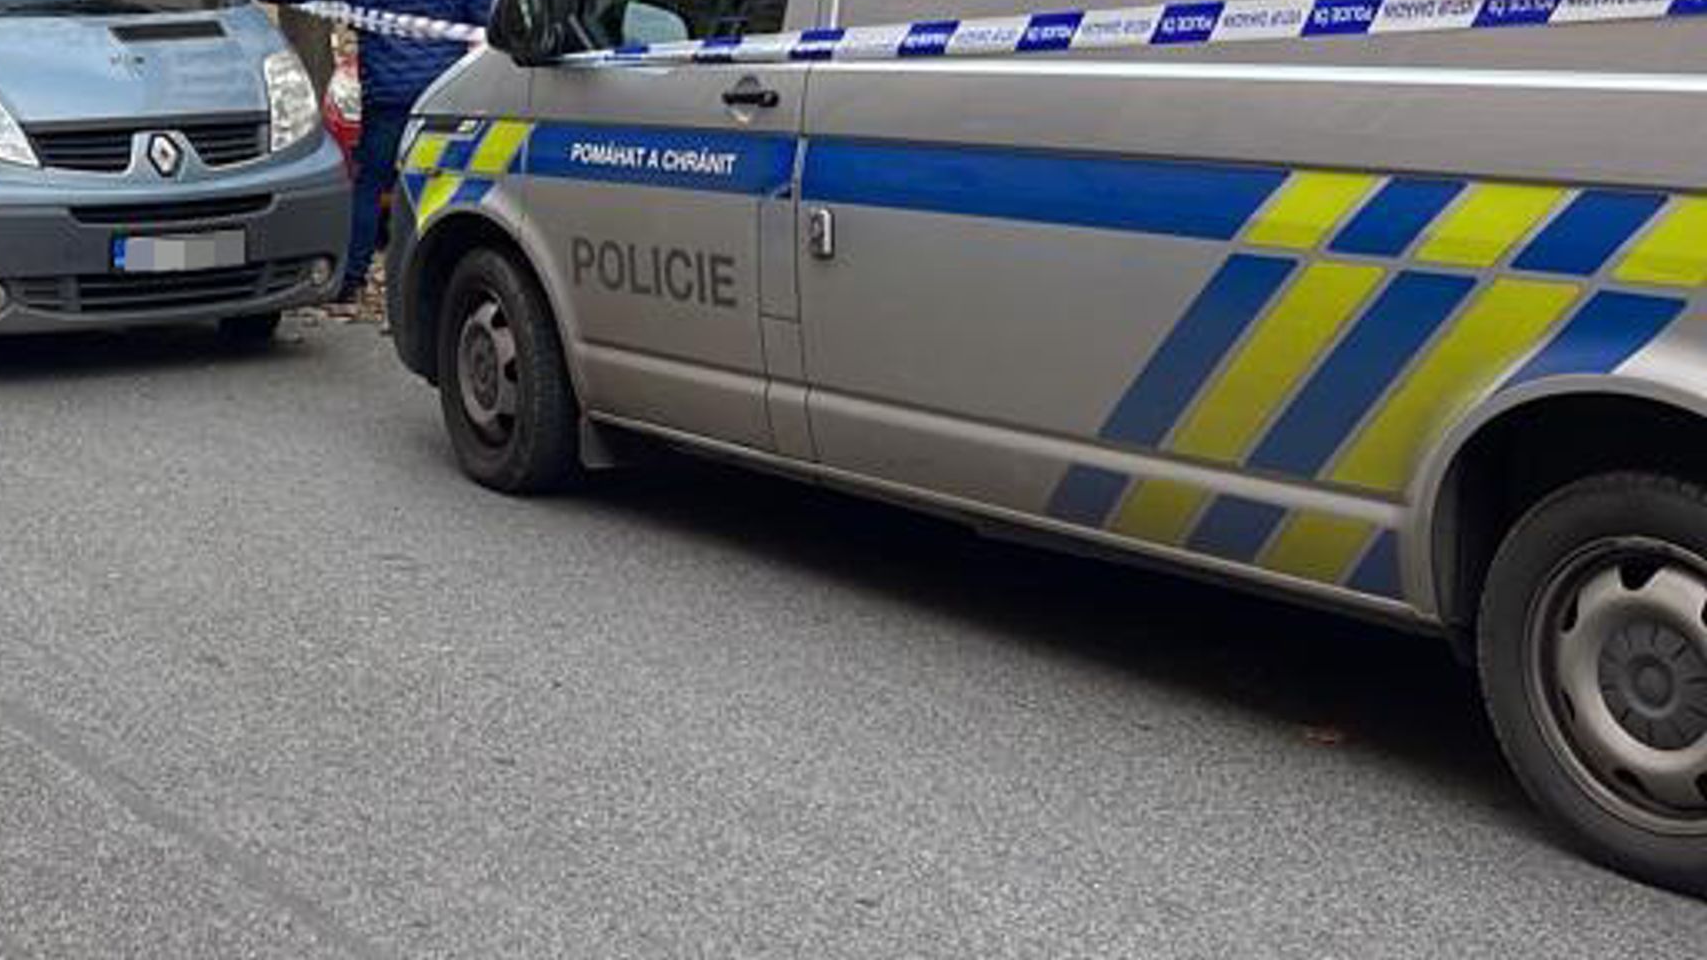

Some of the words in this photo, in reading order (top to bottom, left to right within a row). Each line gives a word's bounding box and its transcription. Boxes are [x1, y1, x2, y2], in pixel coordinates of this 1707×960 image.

[571, 141, 644, 168] POMÁHAT
[647, 149, 659, 168] A
[661, 146, 736, 175] CHRÁNIT
[573, 236, 736, 307] POLICIE
